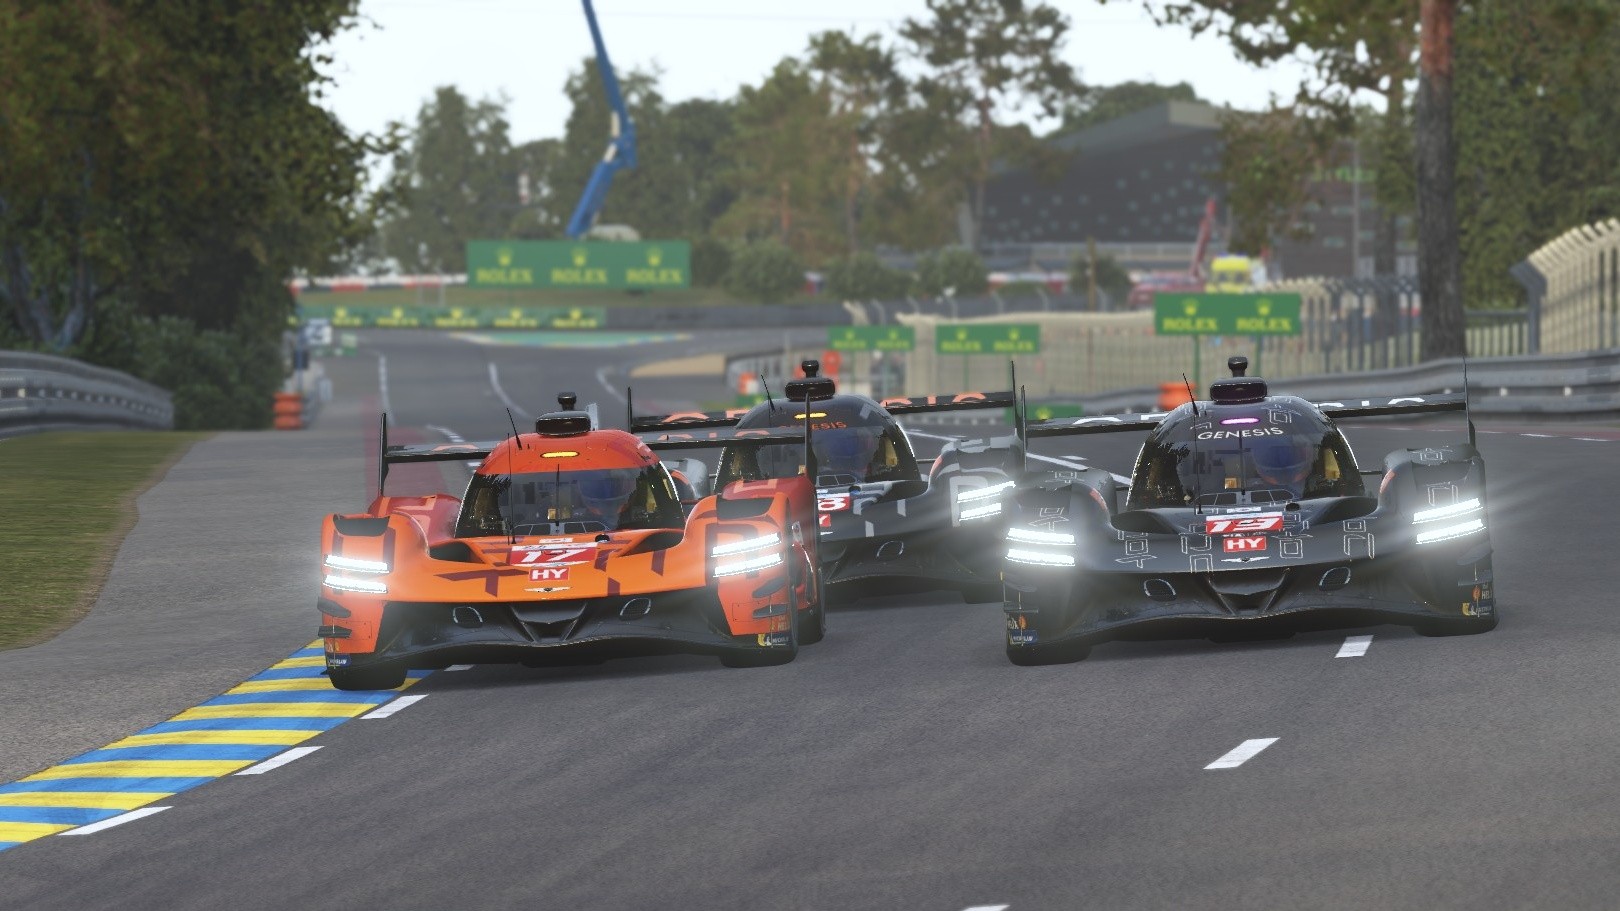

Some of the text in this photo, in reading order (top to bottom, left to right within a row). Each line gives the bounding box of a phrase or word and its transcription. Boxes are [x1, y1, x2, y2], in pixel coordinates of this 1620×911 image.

[476, 268, 682, 284] ROLEX ROLEX ROLEX
[1163, 317, 1291, 332] ROLEX ROLEX
[1197, 427, 1284, 440] GENESIS
[1209, 517, 1280, 533] 19
[1226, 537, 1264, 550] HY
[520, 548, 589, 563] 17
[531, 568, 568, 580] HY
